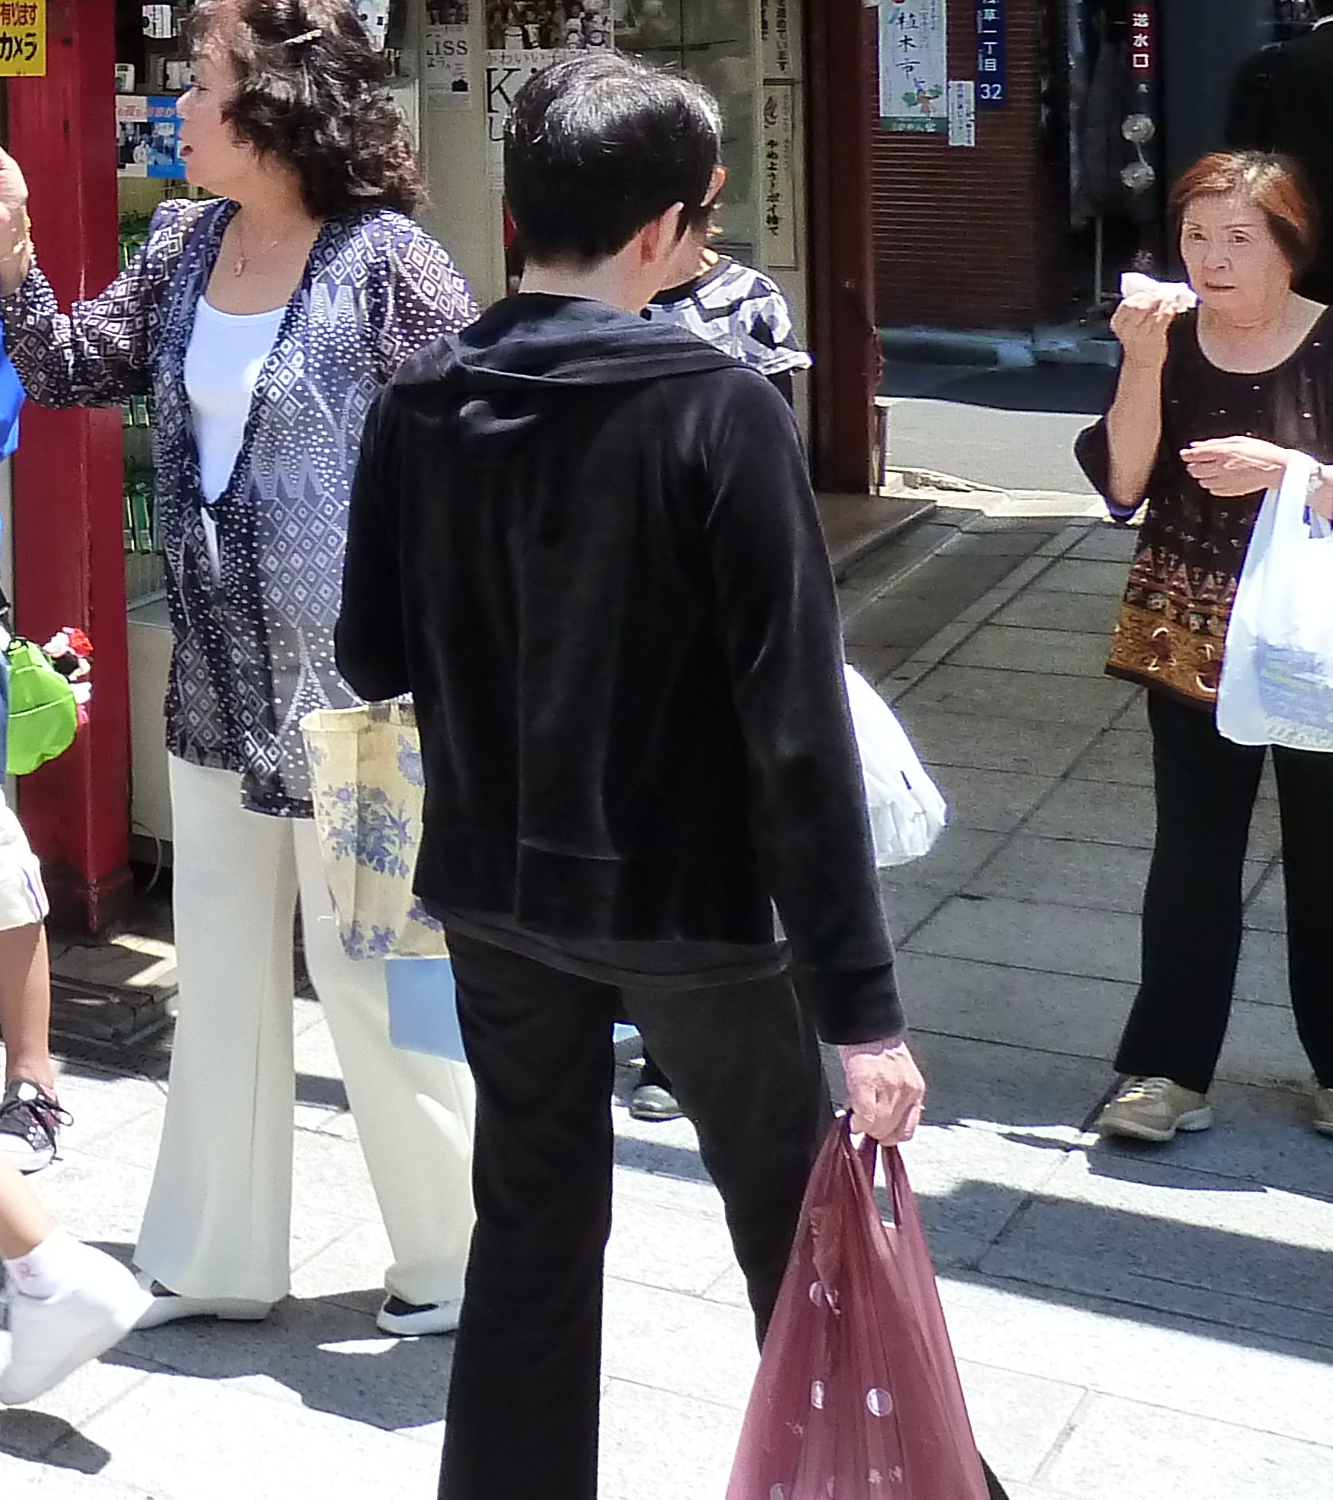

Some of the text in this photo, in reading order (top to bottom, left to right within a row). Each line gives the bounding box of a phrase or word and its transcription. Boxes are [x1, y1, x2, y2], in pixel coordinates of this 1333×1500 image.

[1132, 11, 1150, 69] 送水口
[979, 83, 1003, 100] 32
